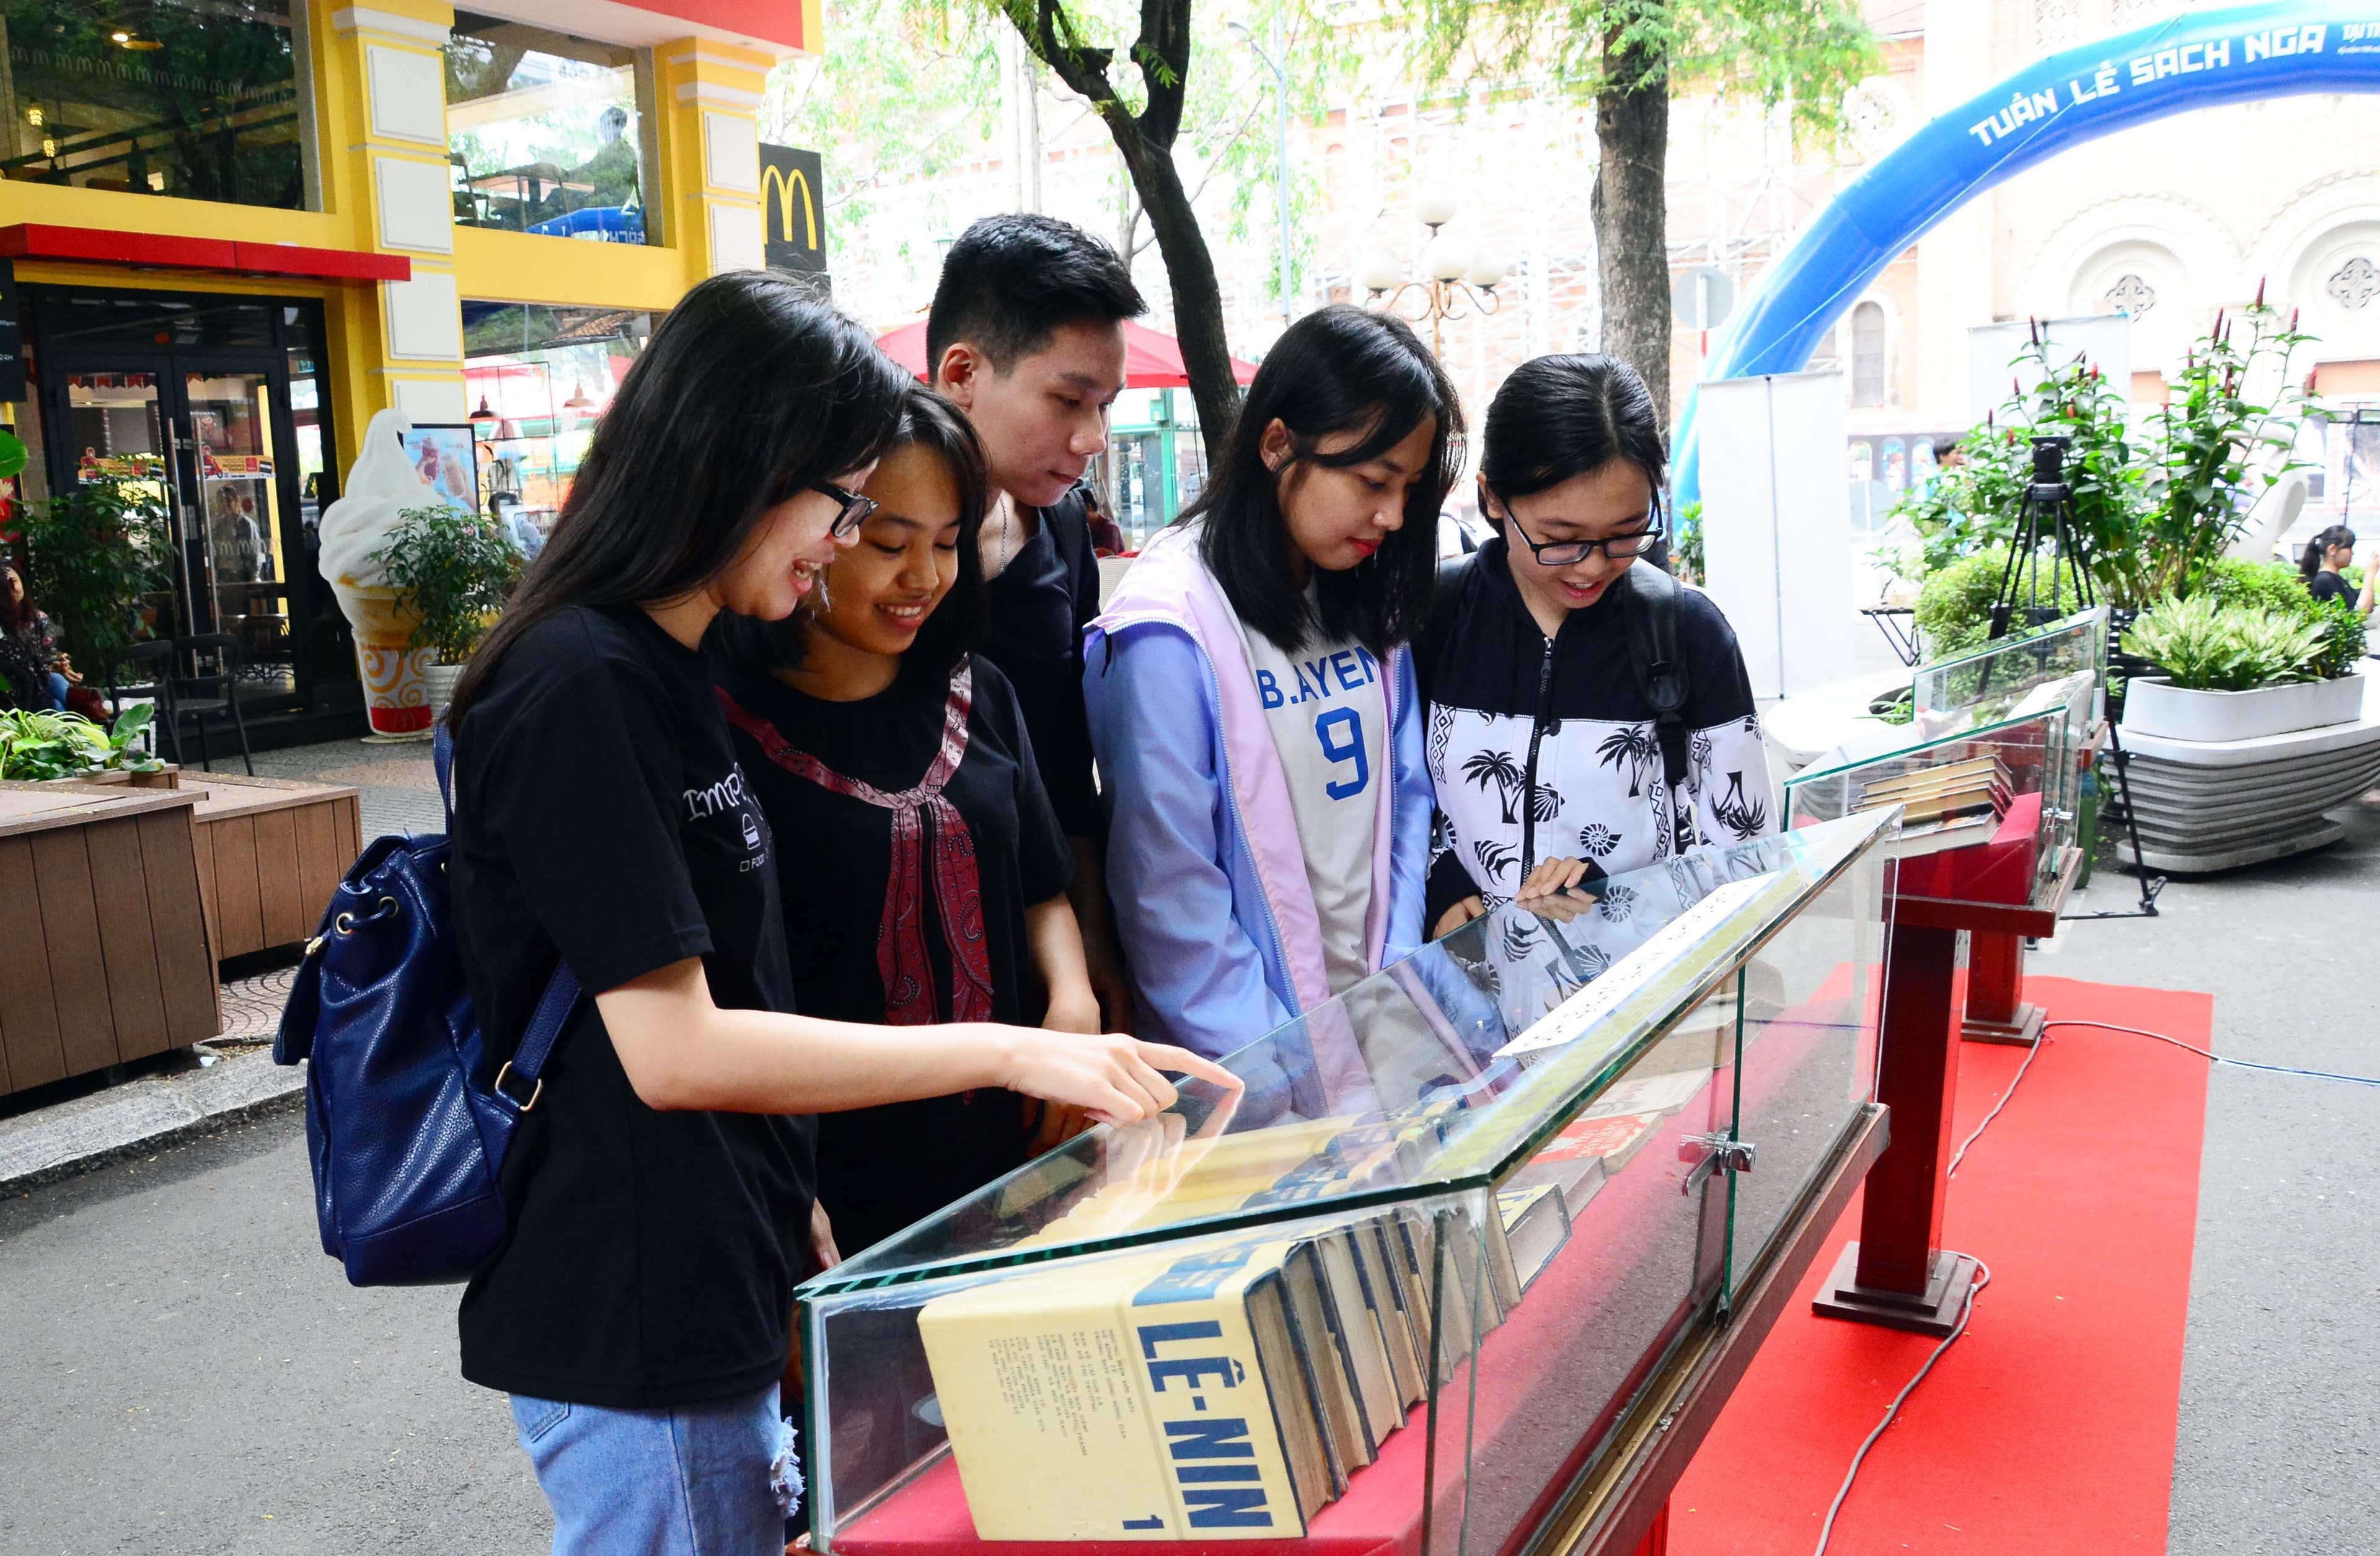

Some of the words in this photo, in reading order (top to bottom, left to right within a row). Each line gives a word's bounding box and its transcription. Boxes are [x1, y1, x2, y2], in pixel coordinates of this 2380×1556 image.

[1968, 87, 2058, 147] TUẦN
[2069, 60, 2120, 105] LỄ
[2129, 41, 2231, 87] SÁCH
[2244, 24, 2327, 63] NGA
[1315, 707, 1369, 801] 9
[1137, 1320, 1274, 1528] LÊ-NIN
[1122, 1514, 1165, 1530] 1
